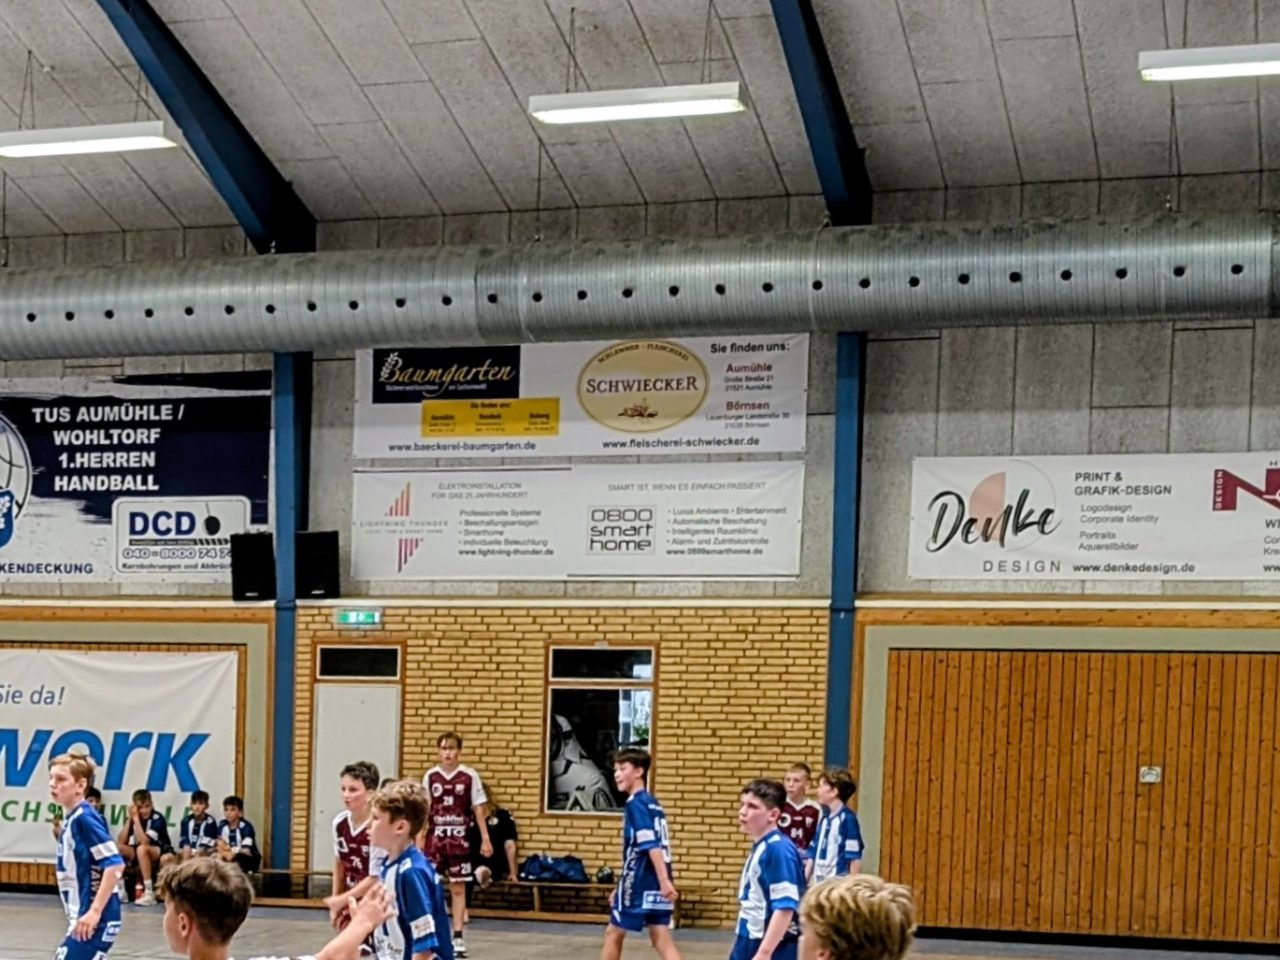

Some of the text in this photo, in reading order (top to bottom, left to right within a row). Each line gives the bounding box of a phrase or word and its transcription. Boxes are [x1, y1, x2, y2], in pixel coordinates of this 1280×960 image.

[711, 342, 790, 354] Sie finden uns:
[726, 363, 773, 374] Aumühle
[379, 356, 516, 396] Baumgarten
[586, 375, 699, 393] SCHWIECKER
[726, 401, 770, 411] Börnsen
[32, 406, 72, 424] TUS
[76, 403, 172, 423] AUMÜHLE
[53, 428, 162, 446] WOHLTORF
[602, 436, 760, 449] www.fleischerei-schwiecker.de
[388, 440, 536, 452] www.baeckerei-baumgarten.de
[57, 450, 157, 469] 1.HERREN
[54, 473, 160, 492] HANDBALL
[1074, 471, 1123, 482] PRINT &
[608, 483, 635, 491] SMART
[691, 482, 726, 491] EINFACH
[726, 481, 767, 490] PASSIERT
[1073, 484, 1172, 496] GRAFIK-DESIGN
[1214, 470, 1224, 510] DESIGN
[510, 509, 542, 518] Systeme
[591, 508, 653, 522] 0800
[1080, 503, 1132, 514] Logodesign
[128, 510, 197, 537] DCD
[925, 487, 1064, 553] Denke
[1080, 514, 1160, 525] Corporate Identity
[590, 523, 653, 537] smart
[1079, 530, 1117, 540] Portraits
[590, 537, 652, 551] home
[1078, 542, 1140, 552] Aquarellbilder
[122, 547, 151, 560] 040
[159, 547, 198, 560] 8000
[198, 547, 218, 560] 74
[184, 562, 198, 570] und
[982, 560, 1061, 573] DESIGN
[1072, 562, 1196, 575] www.denkedesign.de
[30, 684, 66, 707] da!
